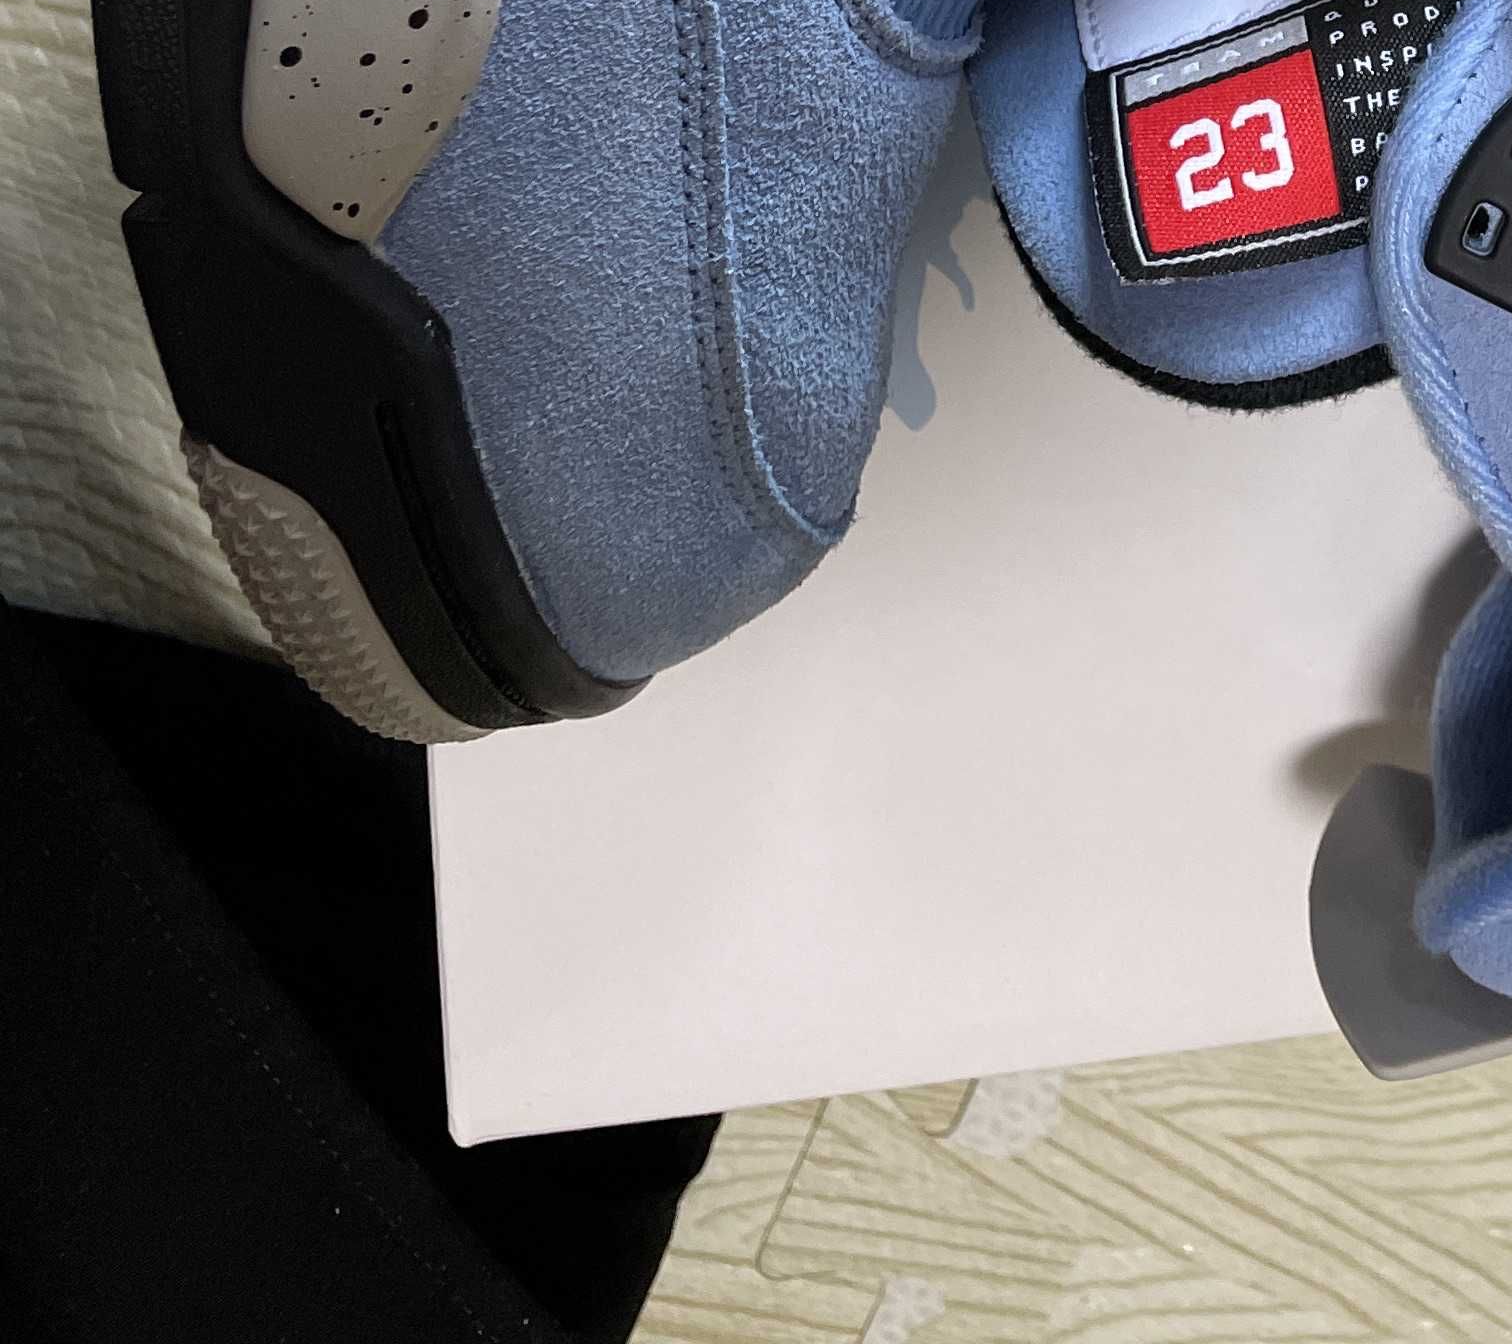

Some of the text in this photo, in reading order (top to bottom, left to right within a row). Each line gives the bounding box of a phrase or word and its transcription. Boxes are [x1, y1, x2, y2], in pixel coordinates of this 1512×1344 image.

[1336, 43, 1433, 78] INSPI
[1342, 87, 1401, 114] THE
[1168, 97, 1295, 213] 23
[1355, 175, 1370, 192] P
